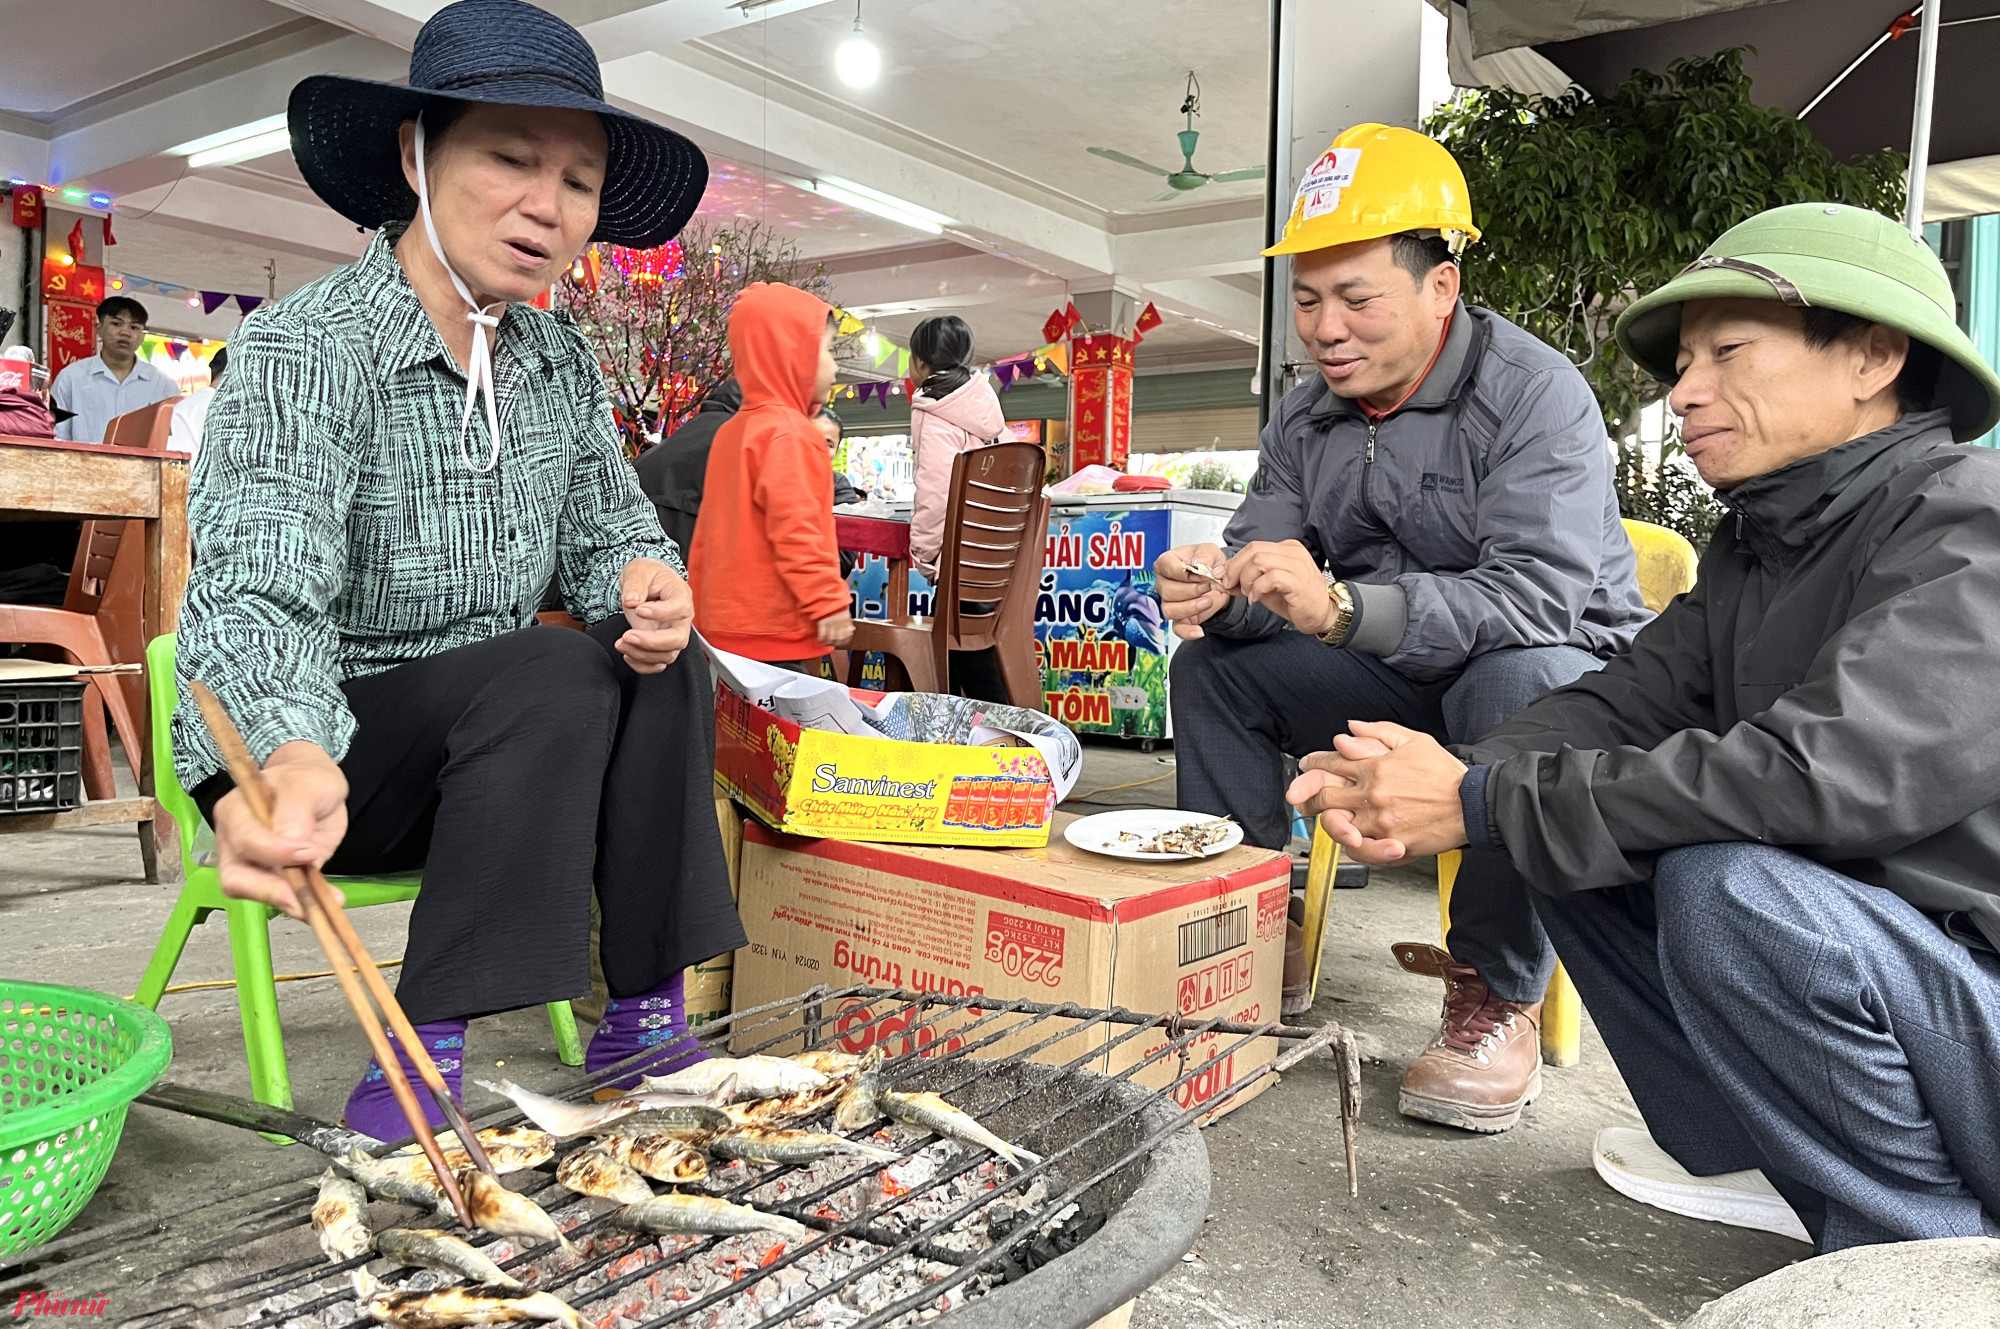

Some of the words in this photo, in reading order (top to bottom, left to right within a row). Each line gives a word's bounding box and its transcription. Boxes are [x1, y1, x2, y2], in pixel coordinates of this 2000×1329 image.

[1042, 525, 1081, 568] HẢI
[1089, 523, 1143, 568] SẢN
[1052, 630, 1128, 671] MẮM
[1046, 688, 1111, 724] TÔM
[813, 764, 938, 800] Sanvinest
[800, 798, 836, 814] Chúc
[836, 800, 876, 818] Mừng
[877, 804, 910, 818] Năm
[911, 804, 939, 820] Mới
[1003, 916, 1023, 928] 220G
[1026, 921, 1032, 931] X
[1034, 923, 1048, 935] TÚI
[1004, 928, 1036, 944] 3.52KG
[1051, 928, 1060, 938] 16
[751, 941, 768, 956] 1320
[882, 940, 889, 948] TY
[795, 954, 819, 971] 020124
[833, 943, 903, 988] trứng
[985, 930, 1061, 988] 220g
